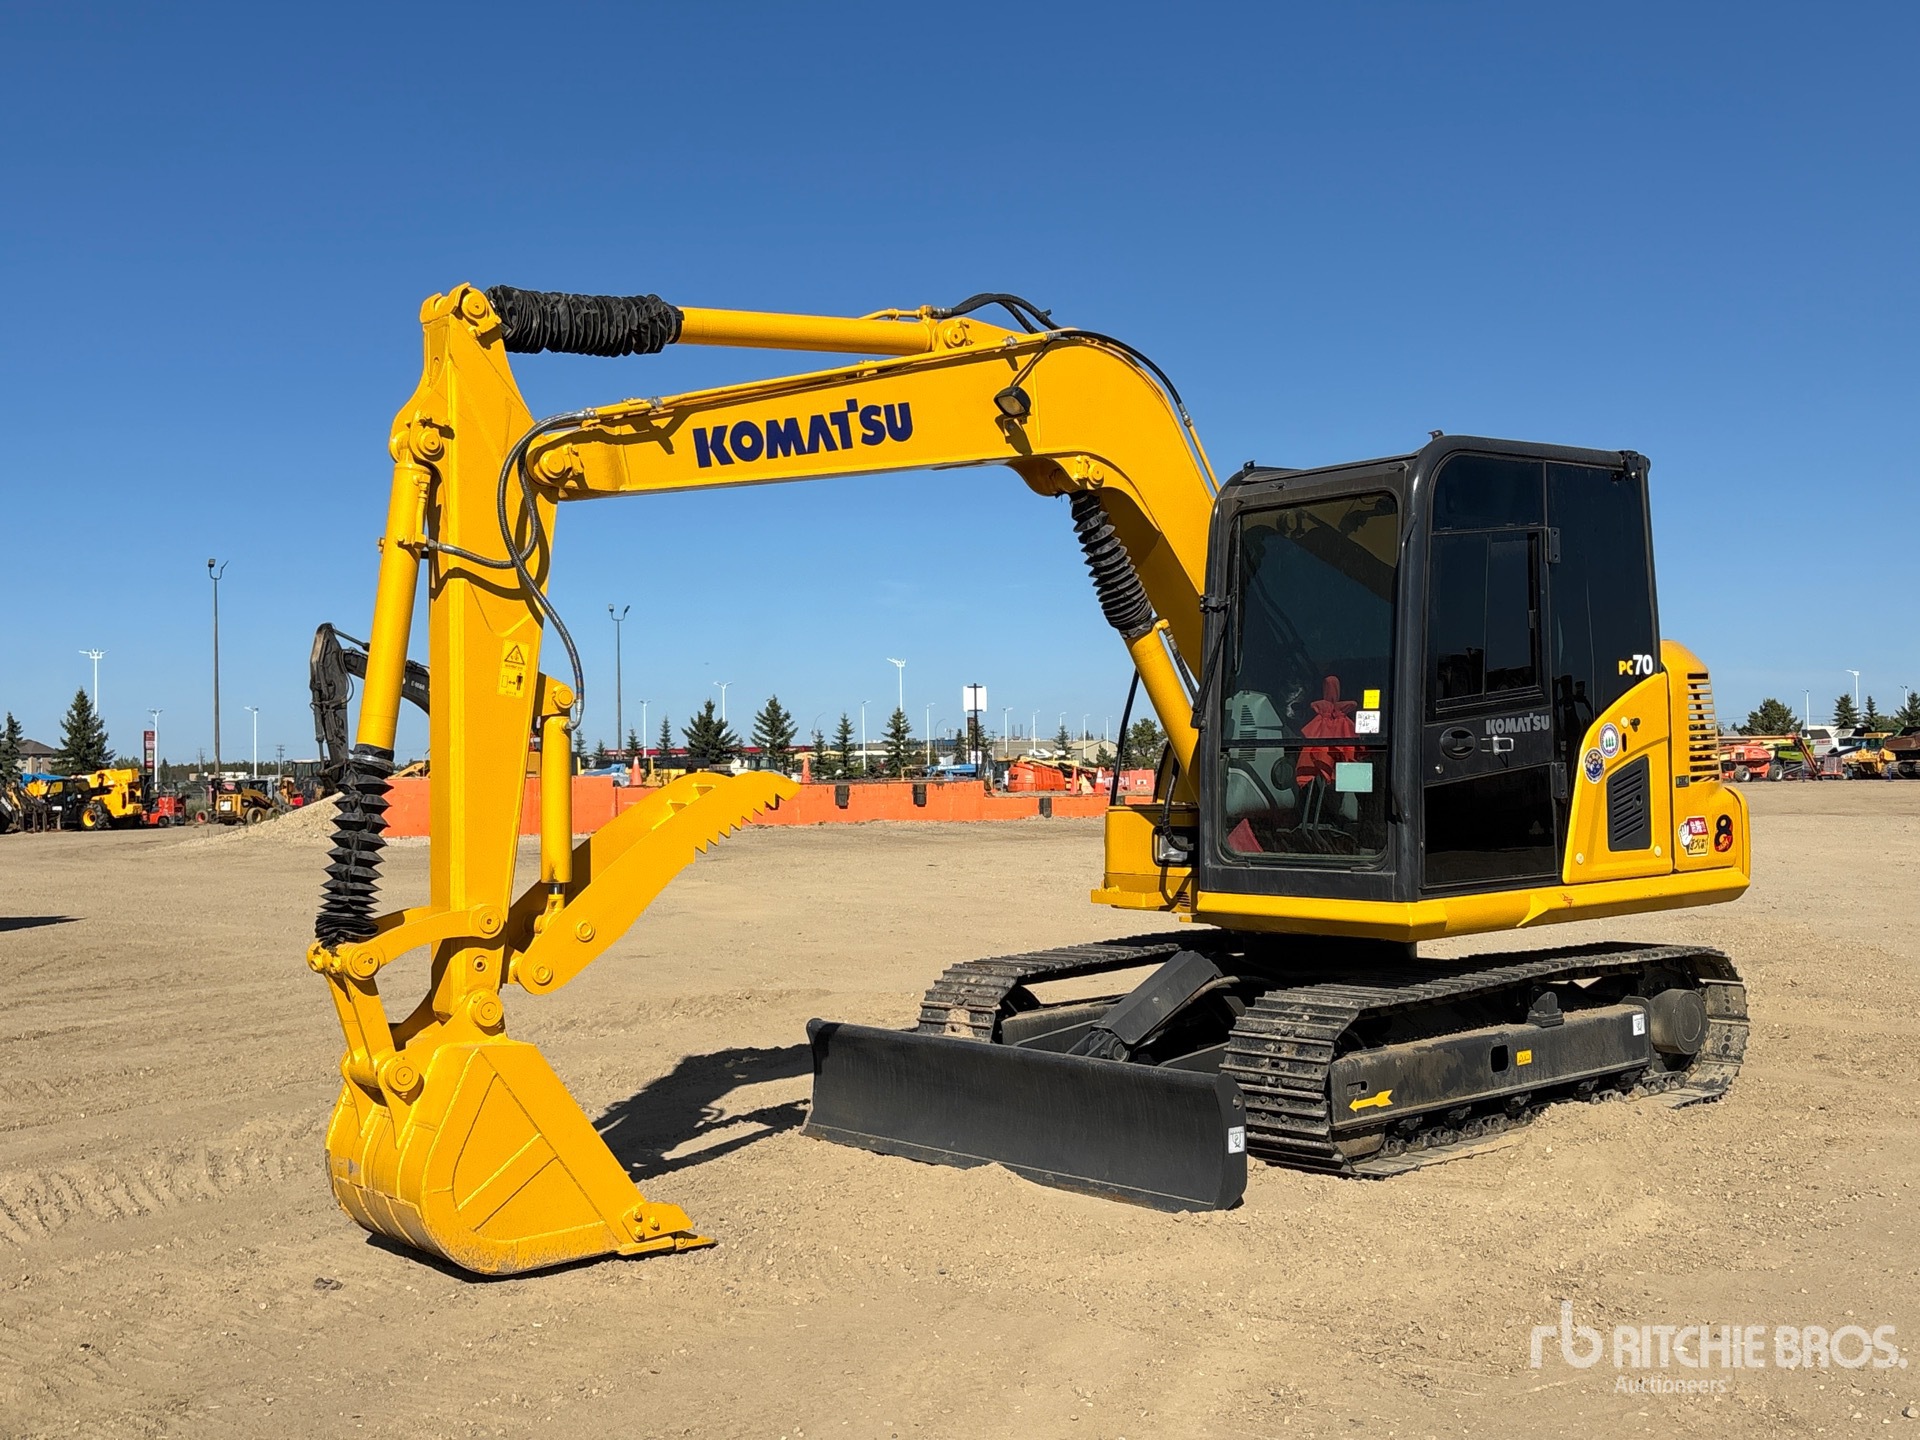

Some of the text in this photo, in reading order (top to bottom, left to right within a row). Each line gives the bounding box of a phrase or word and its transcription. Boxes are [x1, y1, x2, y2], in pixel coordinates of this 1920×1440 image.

[692, 398, 914, 469] KOMATSU
[1618, 654, 1654, 675] PC70
[1485, 712, 1550, 735] KOMATSU
